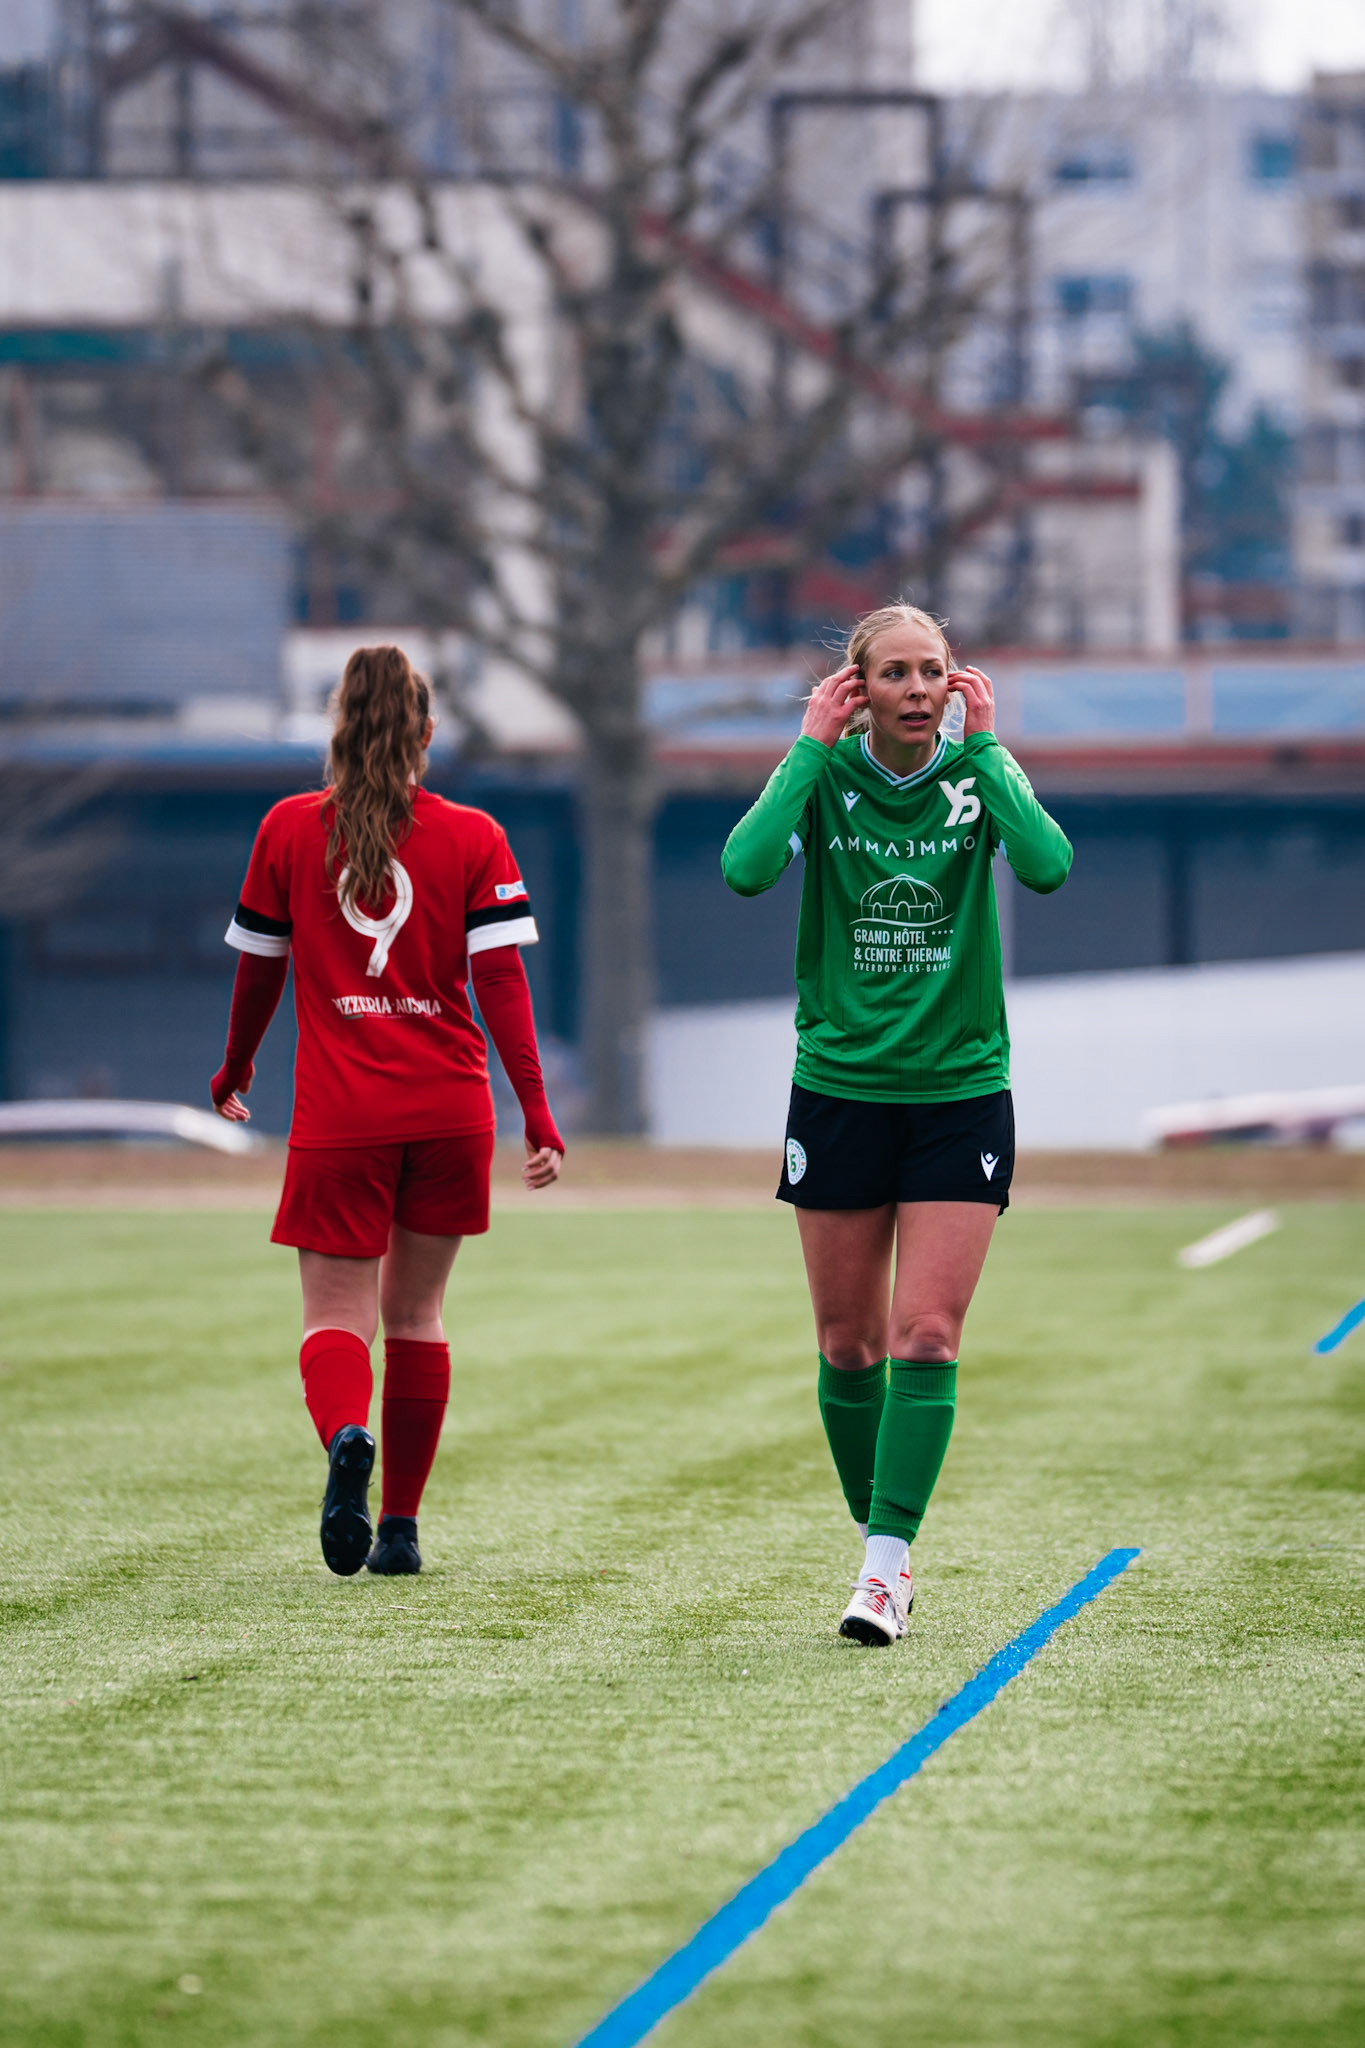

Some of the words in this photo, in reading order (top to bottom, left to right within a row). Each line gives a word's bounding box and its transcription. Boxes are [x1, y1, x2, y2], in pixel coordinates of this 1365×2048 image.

[337, 857, 414, 979] 9
[853, 928, 890, 945] GRAND
[893, 927, 927, 945] HÔTEL
[853, 946, 862, 960] &
[864, 946, 902, 963] CENTRE
[905, 945, 952, 963] THERMAL
